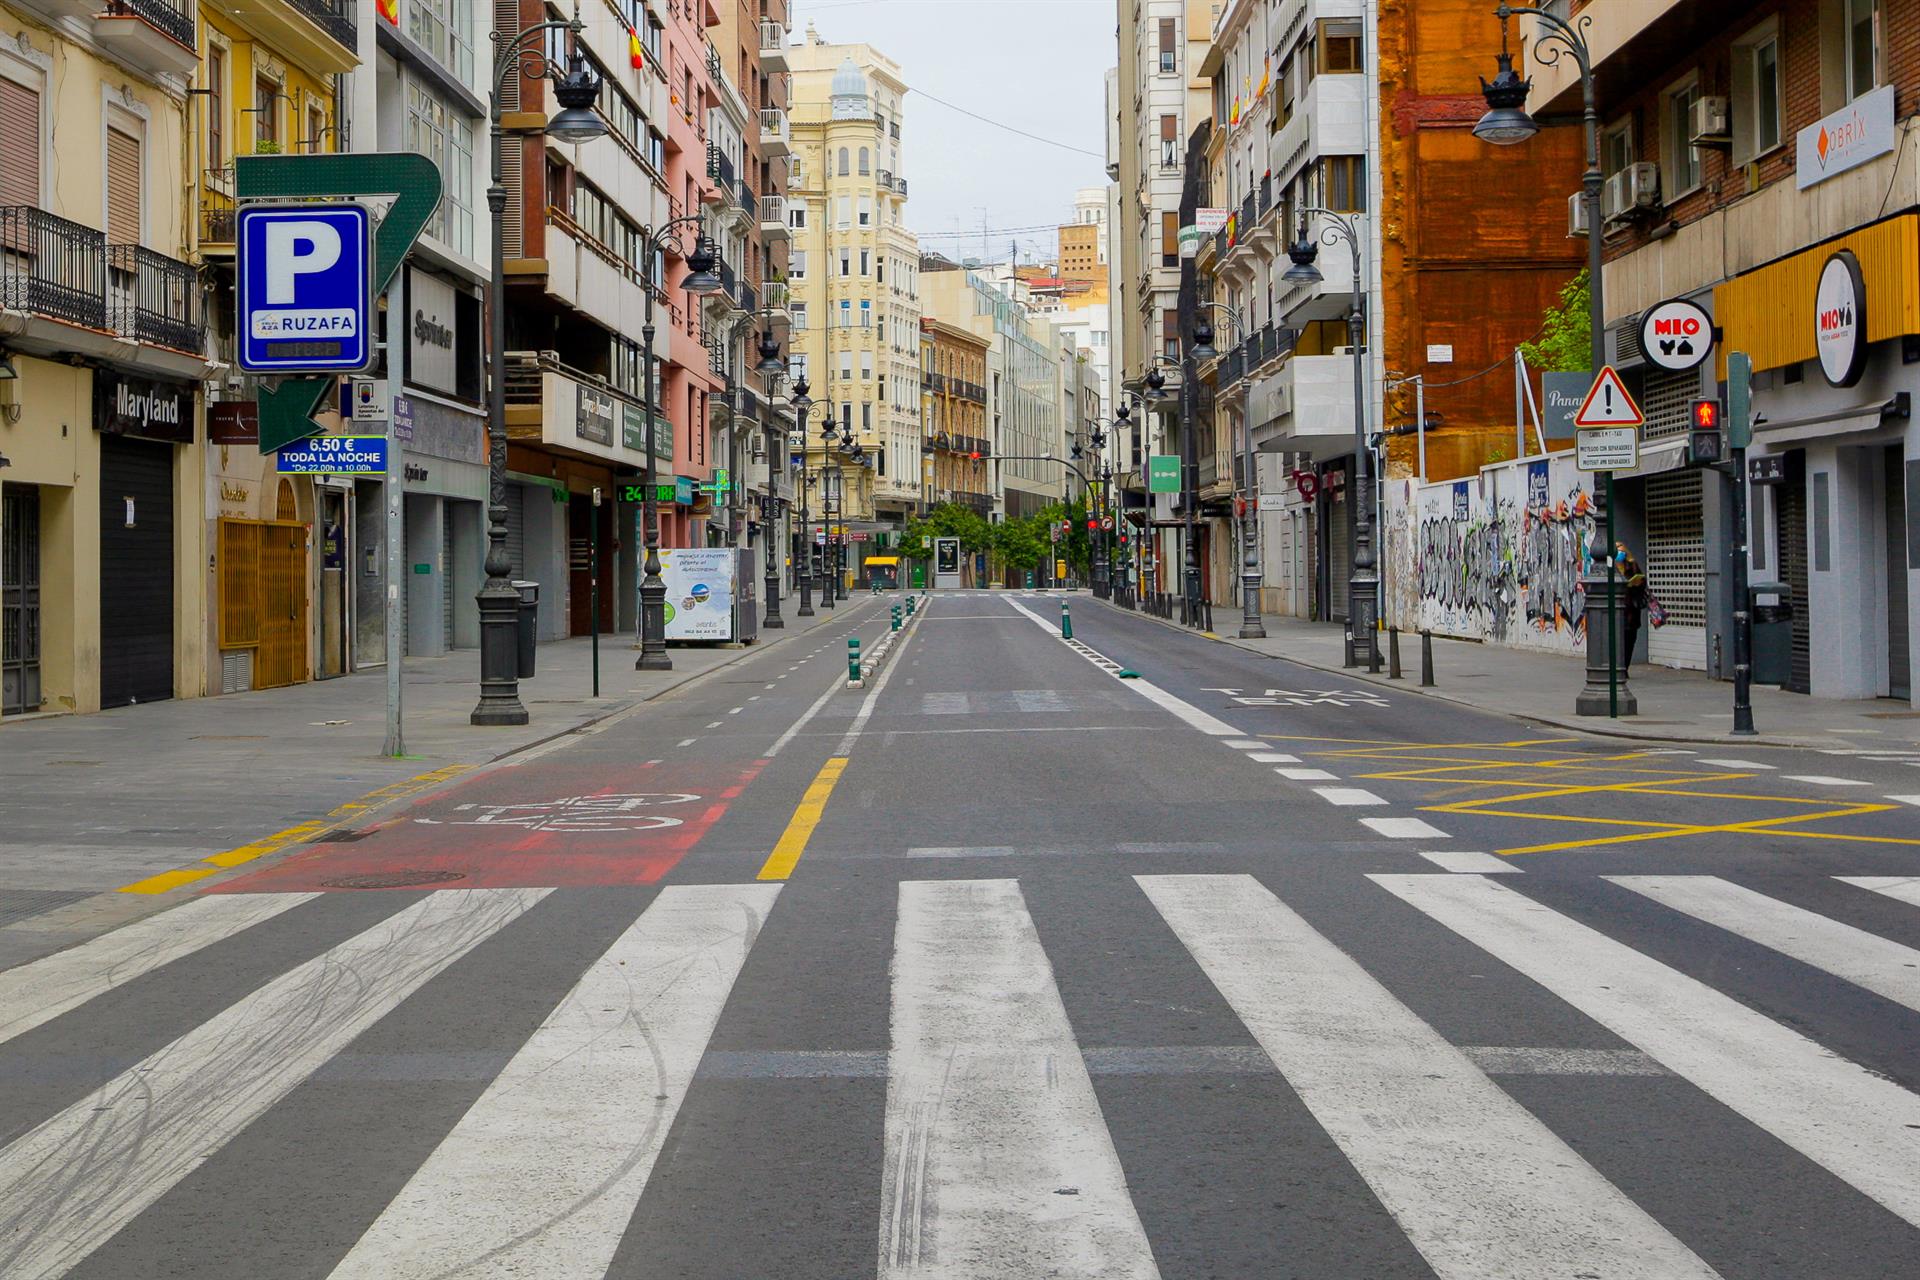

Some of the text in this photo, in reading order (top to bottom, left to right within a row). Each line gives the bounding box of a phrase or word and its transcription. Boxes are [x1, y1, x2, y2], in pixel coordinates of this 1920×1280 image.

[266, 221, 341, 304] P
[282, 317, 352, 331] RUZAFA
[1655, 318, 1700, 335] MIO
[117, 383, 179, 428] Maryland
[309, 438, 354, 452] 6,50 €
[283, 453, 380, 462] TODA LA NOCHE
[625, 486, 642, 501] 24
[1200, 688, 1380, 697] TAXI
